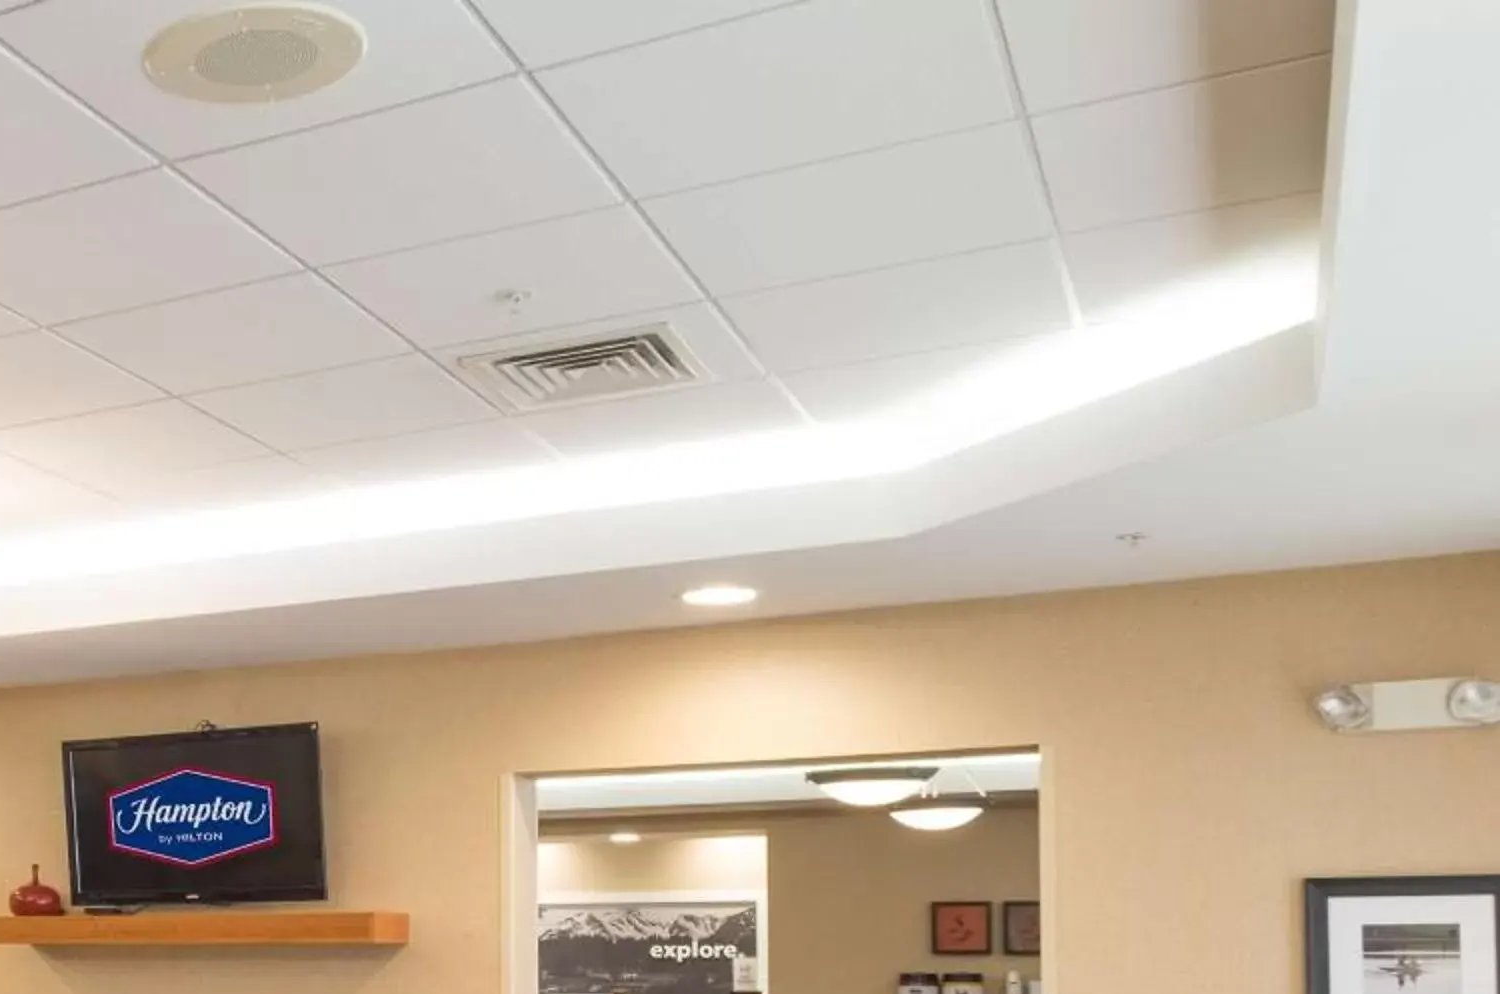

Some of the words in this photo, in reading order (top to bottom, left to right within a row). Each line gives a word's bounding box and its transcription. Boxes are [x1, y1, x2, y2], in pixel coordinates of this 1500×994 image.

[116, 795, 267, 835] Hampton
[158, 835, 173, 845] by
[176, 832, 223, 843] HILTON
